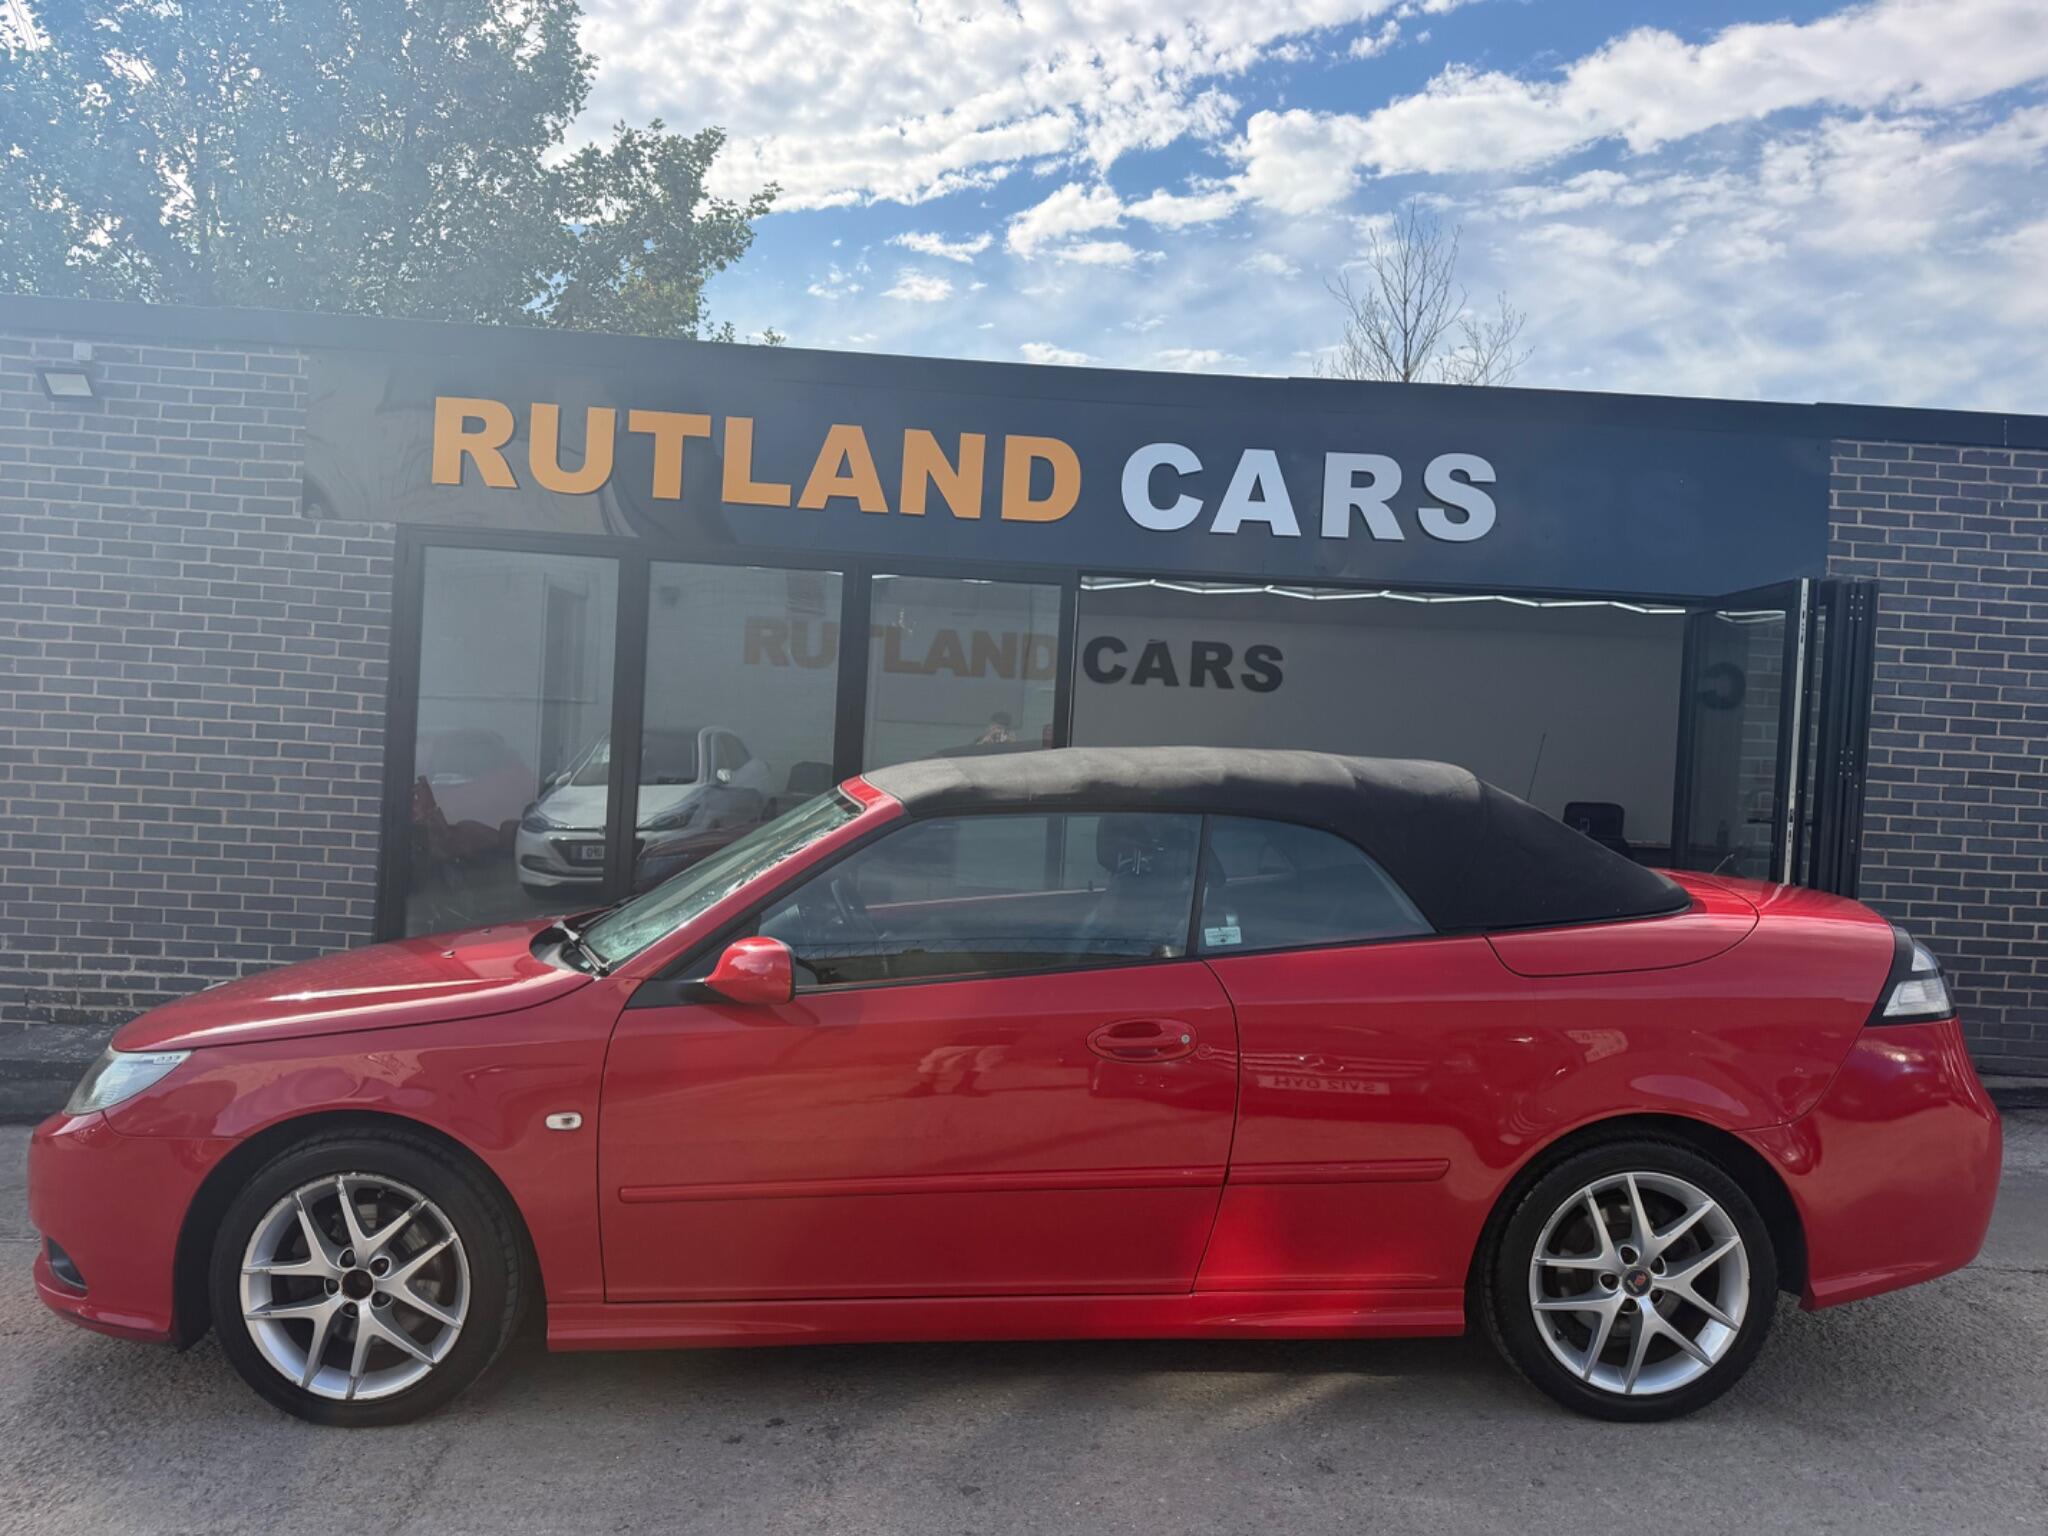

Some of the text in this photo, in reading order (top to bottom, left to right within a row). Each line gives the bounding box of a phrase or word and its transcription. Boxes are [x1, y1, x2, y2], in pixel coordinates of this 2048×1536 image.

[432, 397, 1497, 541] RUTLAND CARS
[1082, 636, 1284, 693] CARS
